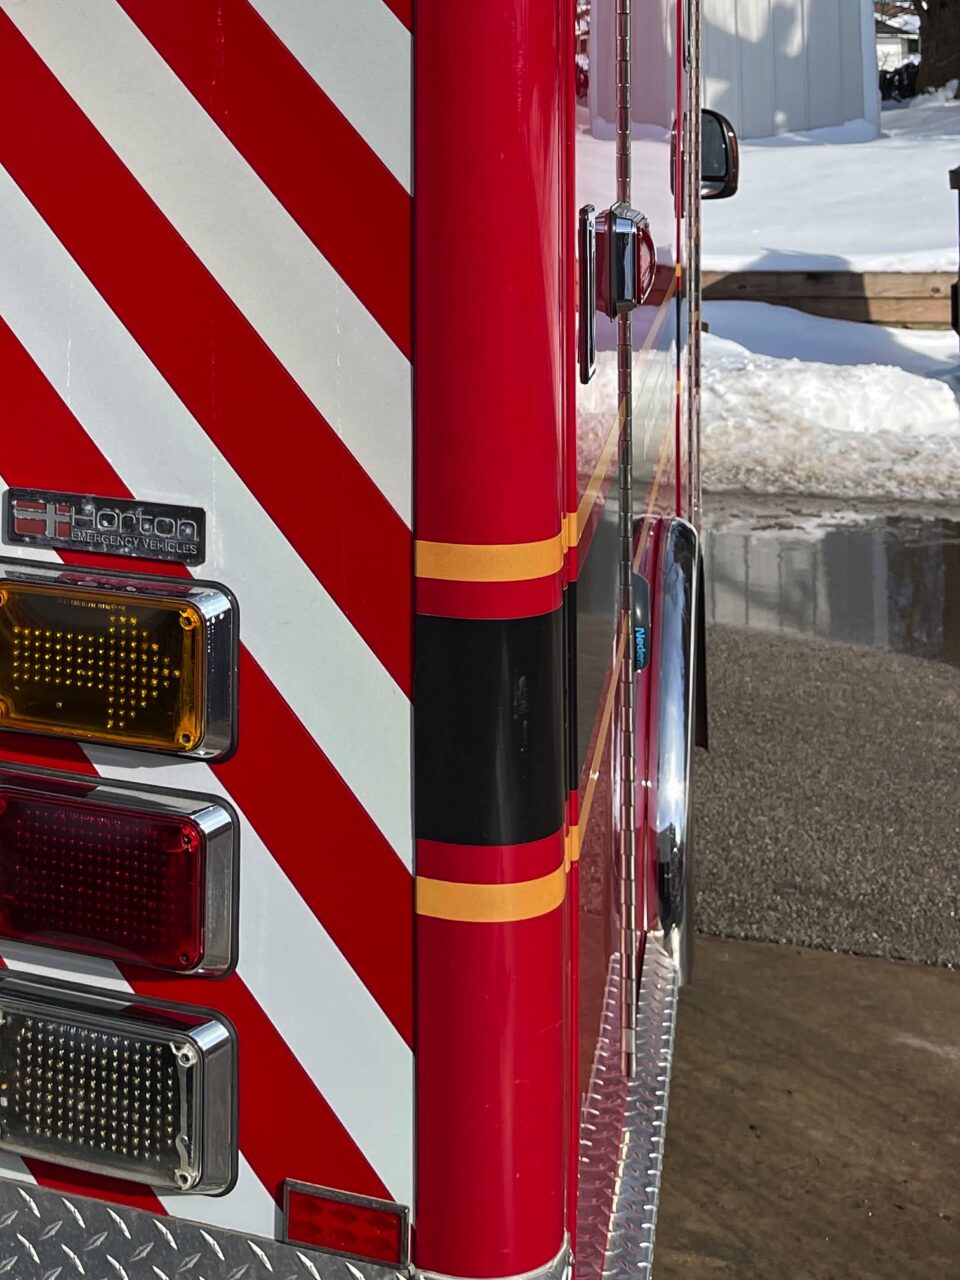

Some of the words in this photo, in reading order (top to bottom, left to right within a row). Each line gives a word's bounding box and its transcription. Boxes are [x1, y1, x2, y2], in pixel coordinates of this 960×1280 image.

[72, 505, 199, 541] Horton
[71, 531, 140, 549] EMERGENCY
[142, 538, 198, 555] VEHICLES
